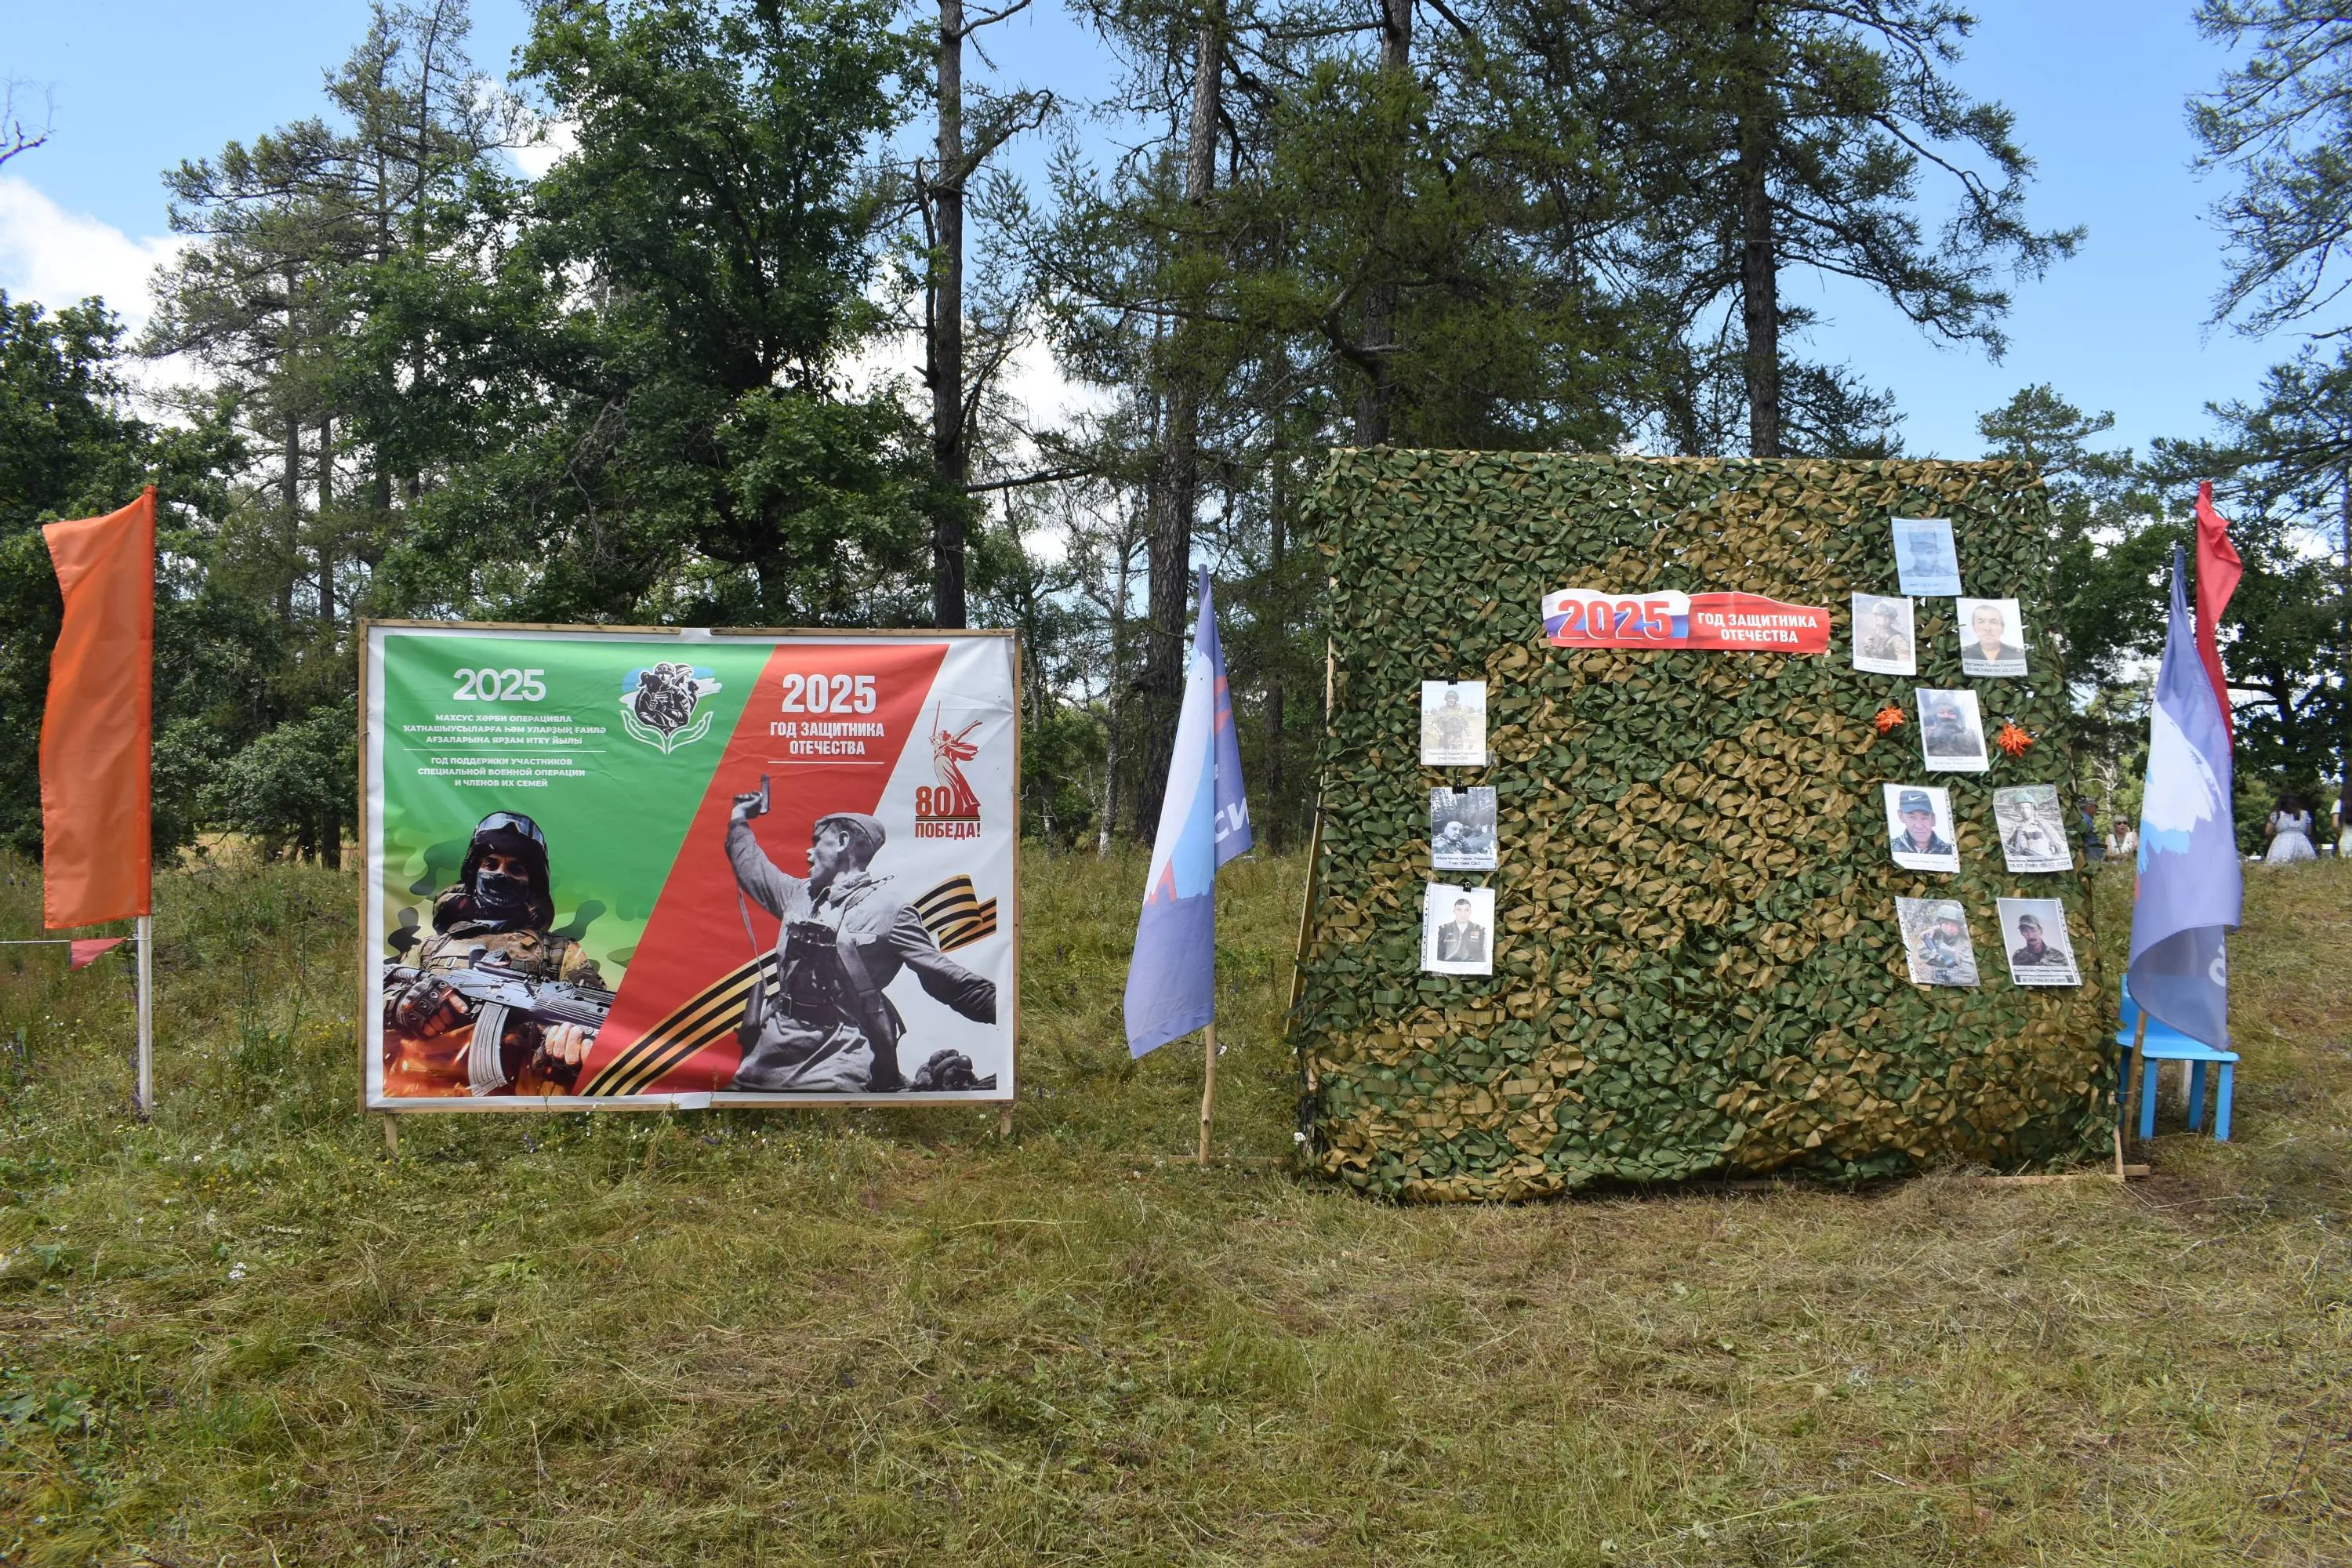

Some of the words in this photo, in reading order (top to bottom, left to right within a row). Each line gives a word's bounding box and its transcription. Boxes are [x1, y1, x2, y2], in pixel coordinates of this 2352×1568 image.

[1557, 599, 1673, 641] 2025
[1697, 612, 1725, 629] ГОД
[1728, 613, 1818, 630] ЗАЩИТНИКА
[1721, 629, 1798, 644] ОТЕЧЕСТВА
[452, 668, 546, 702] 2025
[782, 673, 877, 714] 2025
[770, 721, 797, 738] ГОД
[800, 722, 885, 739] ЗАЩИТНИКА
[552, 736, 583, 745] ЙЫЛЫ
[789, 740, 866, 755] ОТЕЧЕСТВА
[417, 768, 486, 776] СПЕЦИАЛЬНОЙ
[488, 768, 532, 776] ВОЕННОЙ
[517, 779, 548, 787] СЕМЕЙ
[915, 786, 952, 817] 80
[915, 822, 981, 840] ПОБЕДА!
